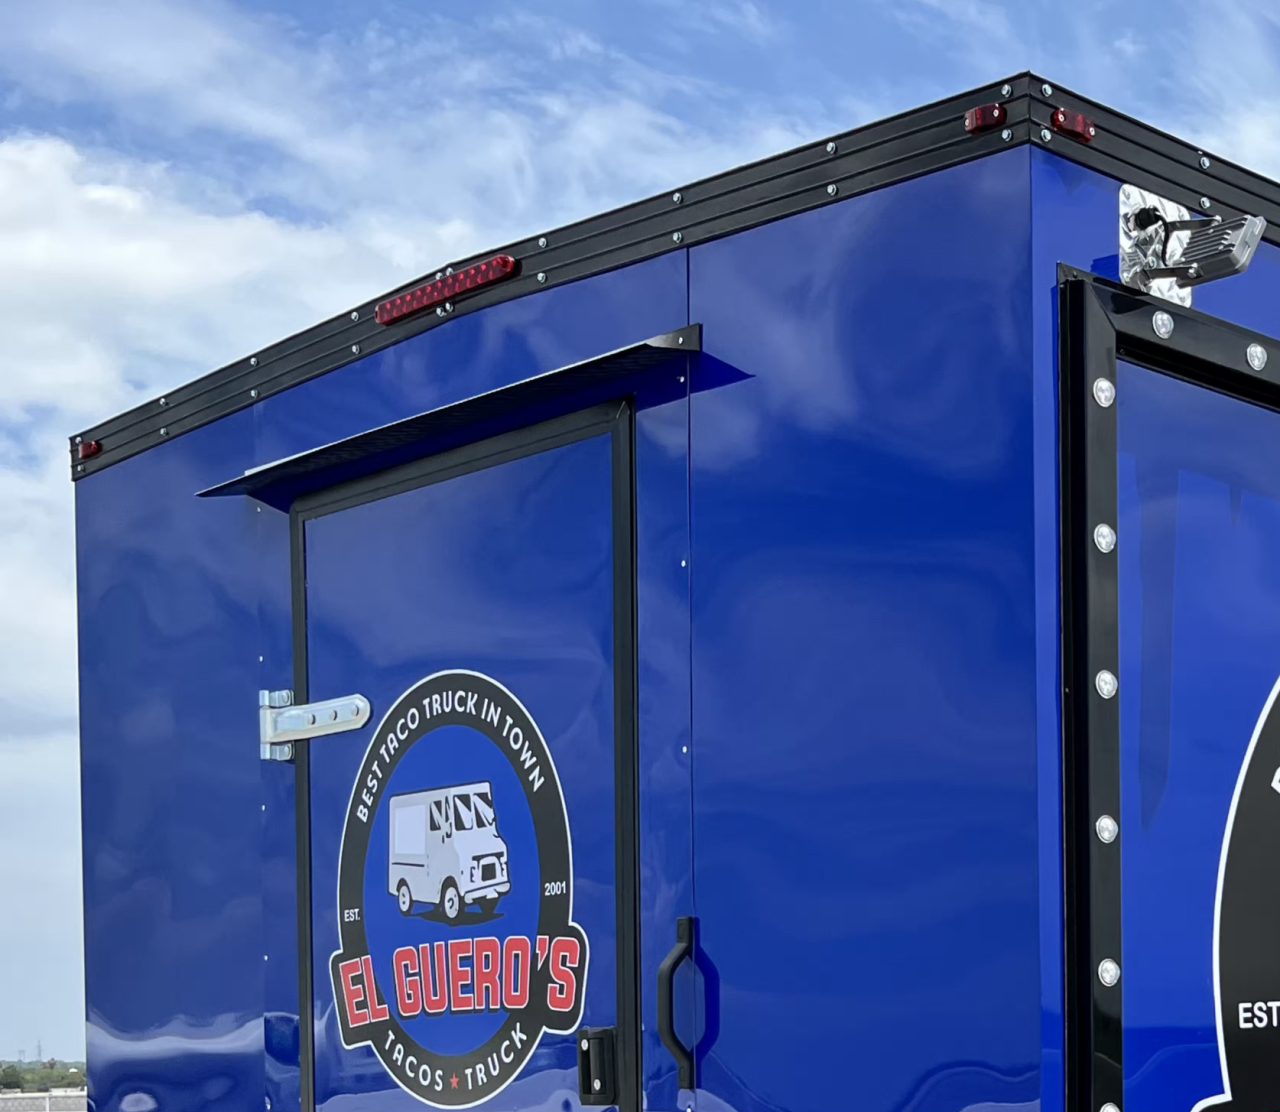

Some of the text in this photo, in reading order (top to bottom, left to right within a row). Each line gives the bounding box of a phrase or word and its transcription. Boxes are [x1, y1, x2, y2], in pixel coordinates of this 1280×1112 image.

[357, 690, 545, 822] BEST TACO TRUCK IN TOWN
[344, 908, 360, 922] EST.
[544, 881, 567, 897] 2001
[339, 936, 580, 1028] EL GUERO'S
[385, 1030, 444, 1091] TACOS
[464, 1022, 527, 1090] TRUCK
